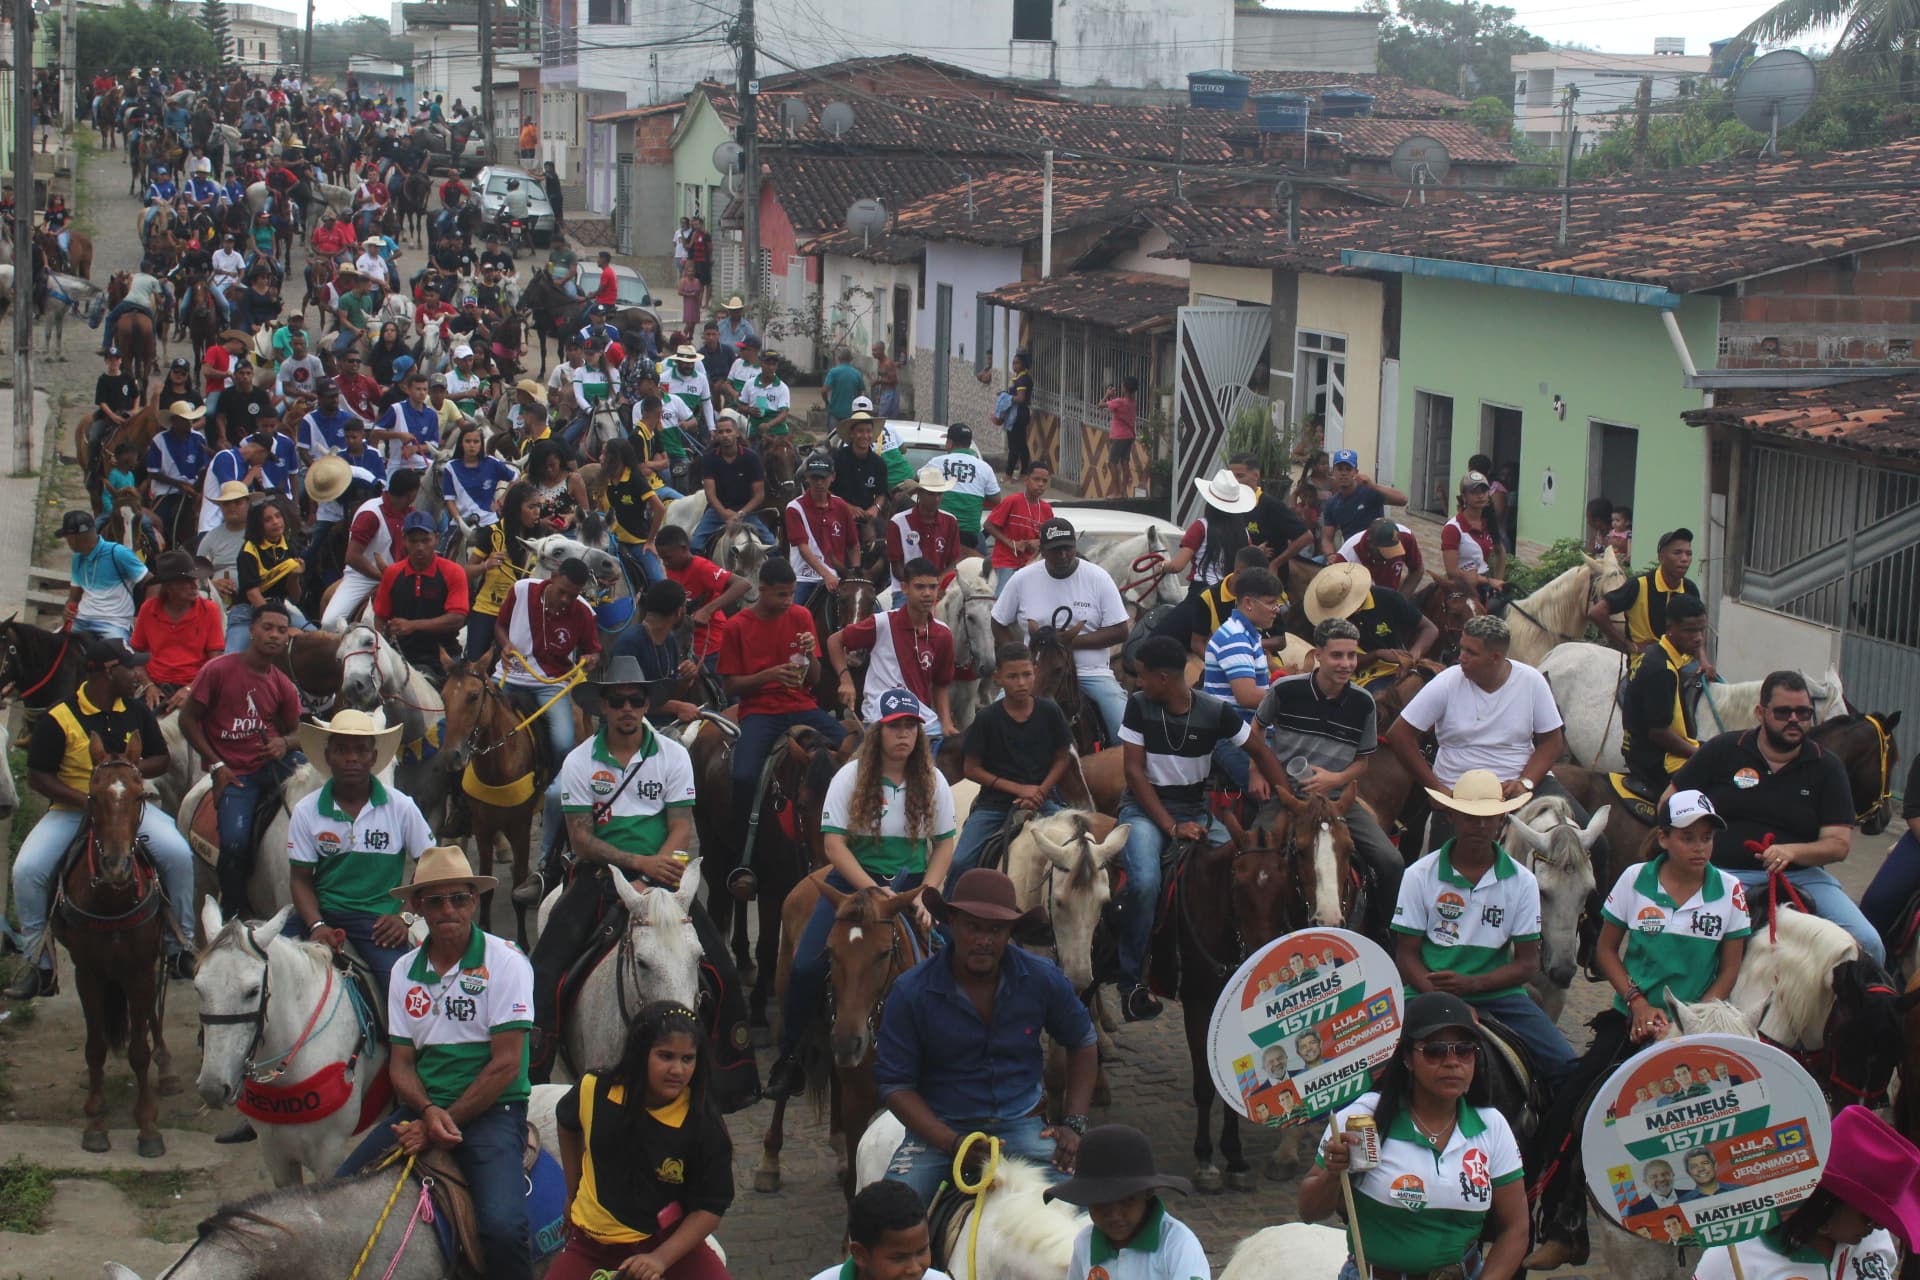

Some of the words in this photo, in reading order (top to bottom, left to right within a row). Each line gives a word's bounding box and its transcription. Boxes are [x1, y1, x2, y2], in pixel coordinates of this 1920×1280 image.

[412, 997, 422, 1008] 13
[1266, 974, 1342, 1018] MATHEUS
[1276, 1011, 1284, 1020] DE
[1286, 998, 1318, 1017] GERALDO
[1278, 996, 1340, 1036] 15777
[1332, 1009, 1366, 1032] LULA
[1369, 999, 1388, 1017] 13
[1381, 1015, 1395, 1031] 13
[1304, 1058, 1368, 1095] MATHEUS
[1307, 1072, 1364, 1112] 15777
[1645, 1093, 1740, 1130] MATHEUS
[1658, 1125, 1670, 1134] DE
[1670, 1115, 1710, 1131] GERALDO
[1365, 1127, 1378, 1163] ITAIPAVA
[1661, 1116, 1736, 1153] 15777
[1729, 1136, 1774, 1156] LULA
[1777, 1129, 1802, 1146] 13
[1474, 1162, 1483, 1175] 13
[1792, 1149, 1810, 1164] 13
[1785, 1182, 1818, 1195] GERALDO
[1695, 1195, 1775, 1225] MATHEUS
[1698, 1210, 1771, 1243] 15777
